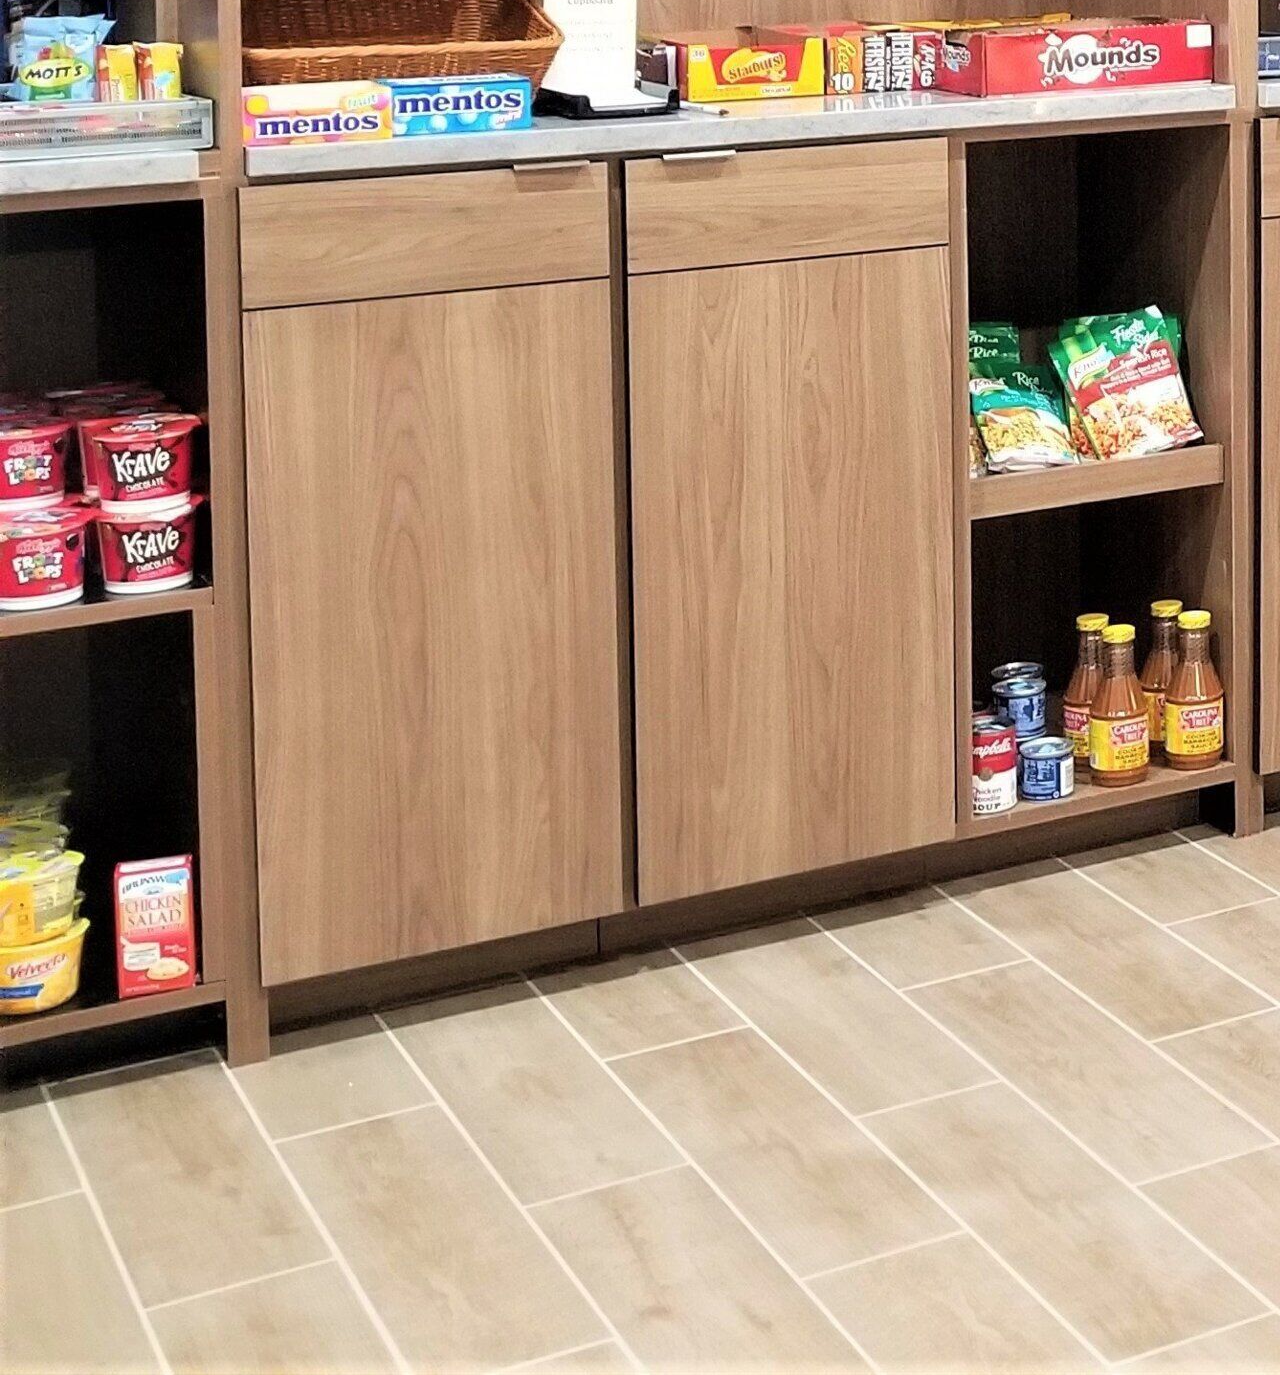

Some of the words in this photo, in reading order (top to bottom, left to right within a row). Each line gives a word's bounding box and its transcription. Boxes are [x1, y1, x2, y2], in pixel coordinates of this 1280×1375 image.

[1046, 47, 1158, 75] Mounds
[832, 73, 854, 92] 10
[397, 90, 522, 114] mentos
[258, 112, 379, 136] mentos
[969, 346, 998, 358] Rice
[1012, 371, 1040, 387] Rice
[125, 895, 183, 914] CHICKEN
[127, 908, 183, 927] SALAD
